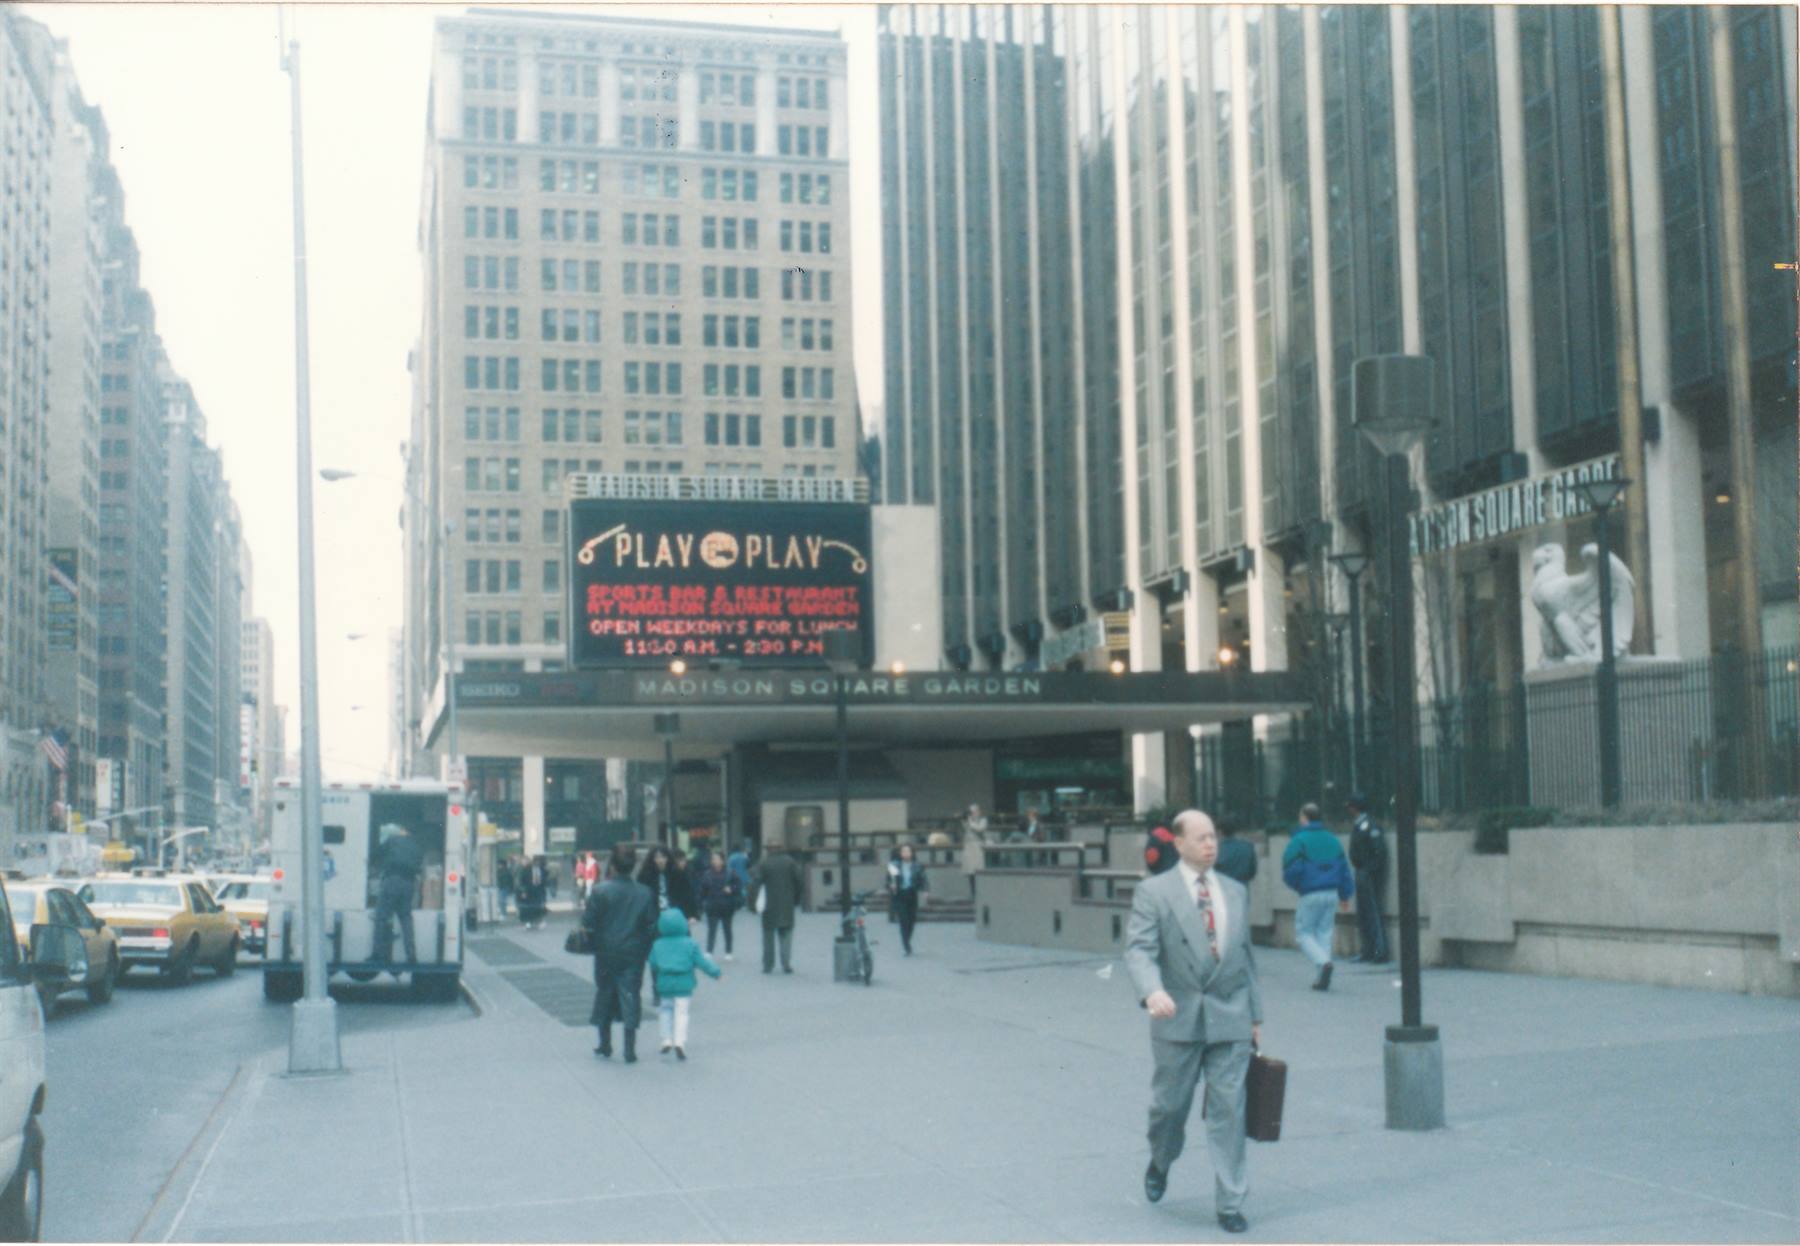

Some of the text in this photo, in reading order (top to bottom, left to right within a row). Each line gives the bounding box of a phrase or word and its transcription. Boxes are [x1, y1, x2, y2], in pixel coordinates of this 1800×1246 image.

[1473, 479, 1546, 540] SQUARE
[616, 533, 693, 568] PLAY
[746, 534, 822, 569] PLAY
[587, 584, 663, 600] SPORTS
[670, 585, 705, 600] BAR
[619, 600, 705, 616] MADISON
[709, 600, 783, 616] SQUARE
[788, 600, 859, 616] GARDEN
[590, 620, 640, 635] OPEN
[646, 620, 748, 635] WEEKDAYS
[754, 620, 792, 635] FOR
[744, 639, 785, 656] 2:30
[638, 678, 1041, 696] MADISON SQUARE GARDEN
